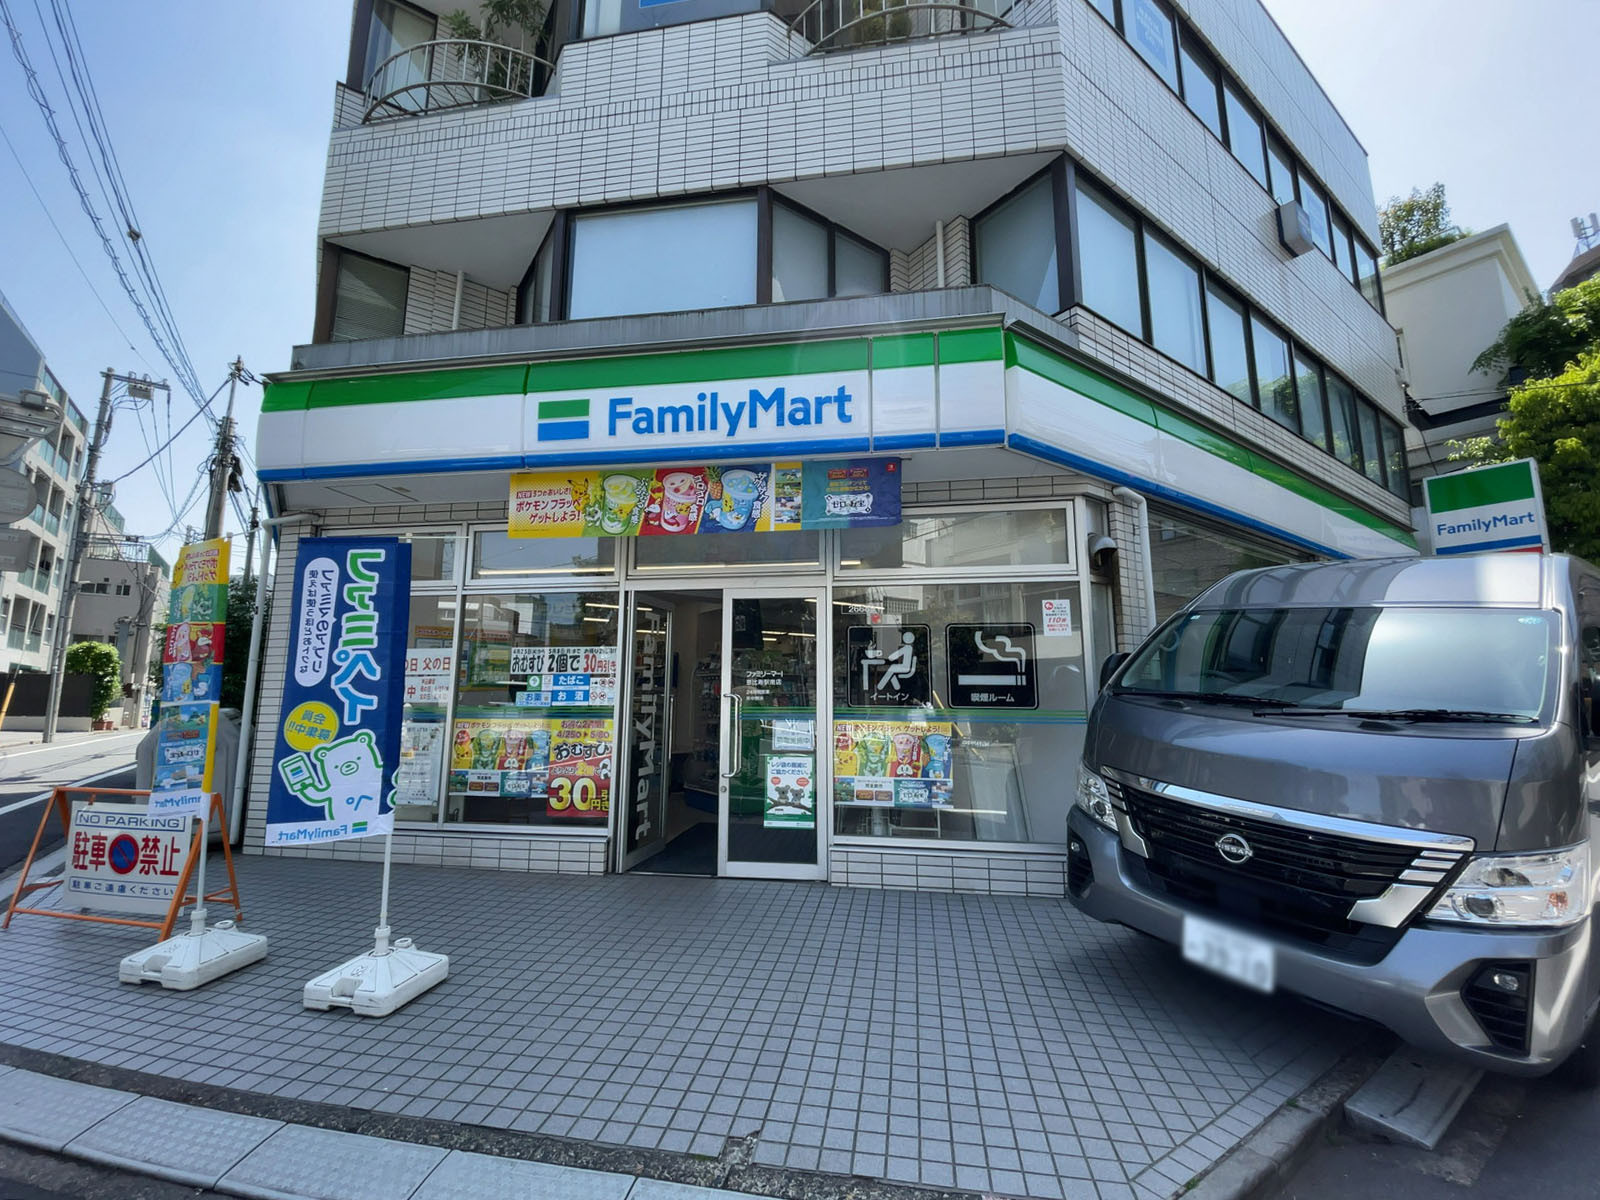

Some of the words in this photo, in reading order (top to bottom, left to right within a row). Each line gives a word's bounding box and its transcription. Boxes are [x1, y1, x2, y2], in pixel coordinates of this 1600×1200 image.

[608, 385, 853, 437] FamilyMart
[515, 498, 582, 513] ポケモンフラッペ
[529, 510, 581, 525] ゲットしよう!
[1437, 512, 1535, 536] FamilyMart
[423, 657, 451, 671] 父の日
[512, 655, 545, 672] おむすび
[548, 654, 580, 672] 2個で
[558, 675, 585, 685] たばこ
[870, 692, 910, 702] イートイン
[970, 692, 1015, 703] 喫煙ルーム
[635, 612, 660, 841] FamilyMart
[79, 813, 101, 824] NO
[105, 815, 180, 828] PARKING
[72, 832, 108, 872] 駐車
[139, 834, 181, 877] 禁止
[1214, 841, 1253, 857] NISSAN
